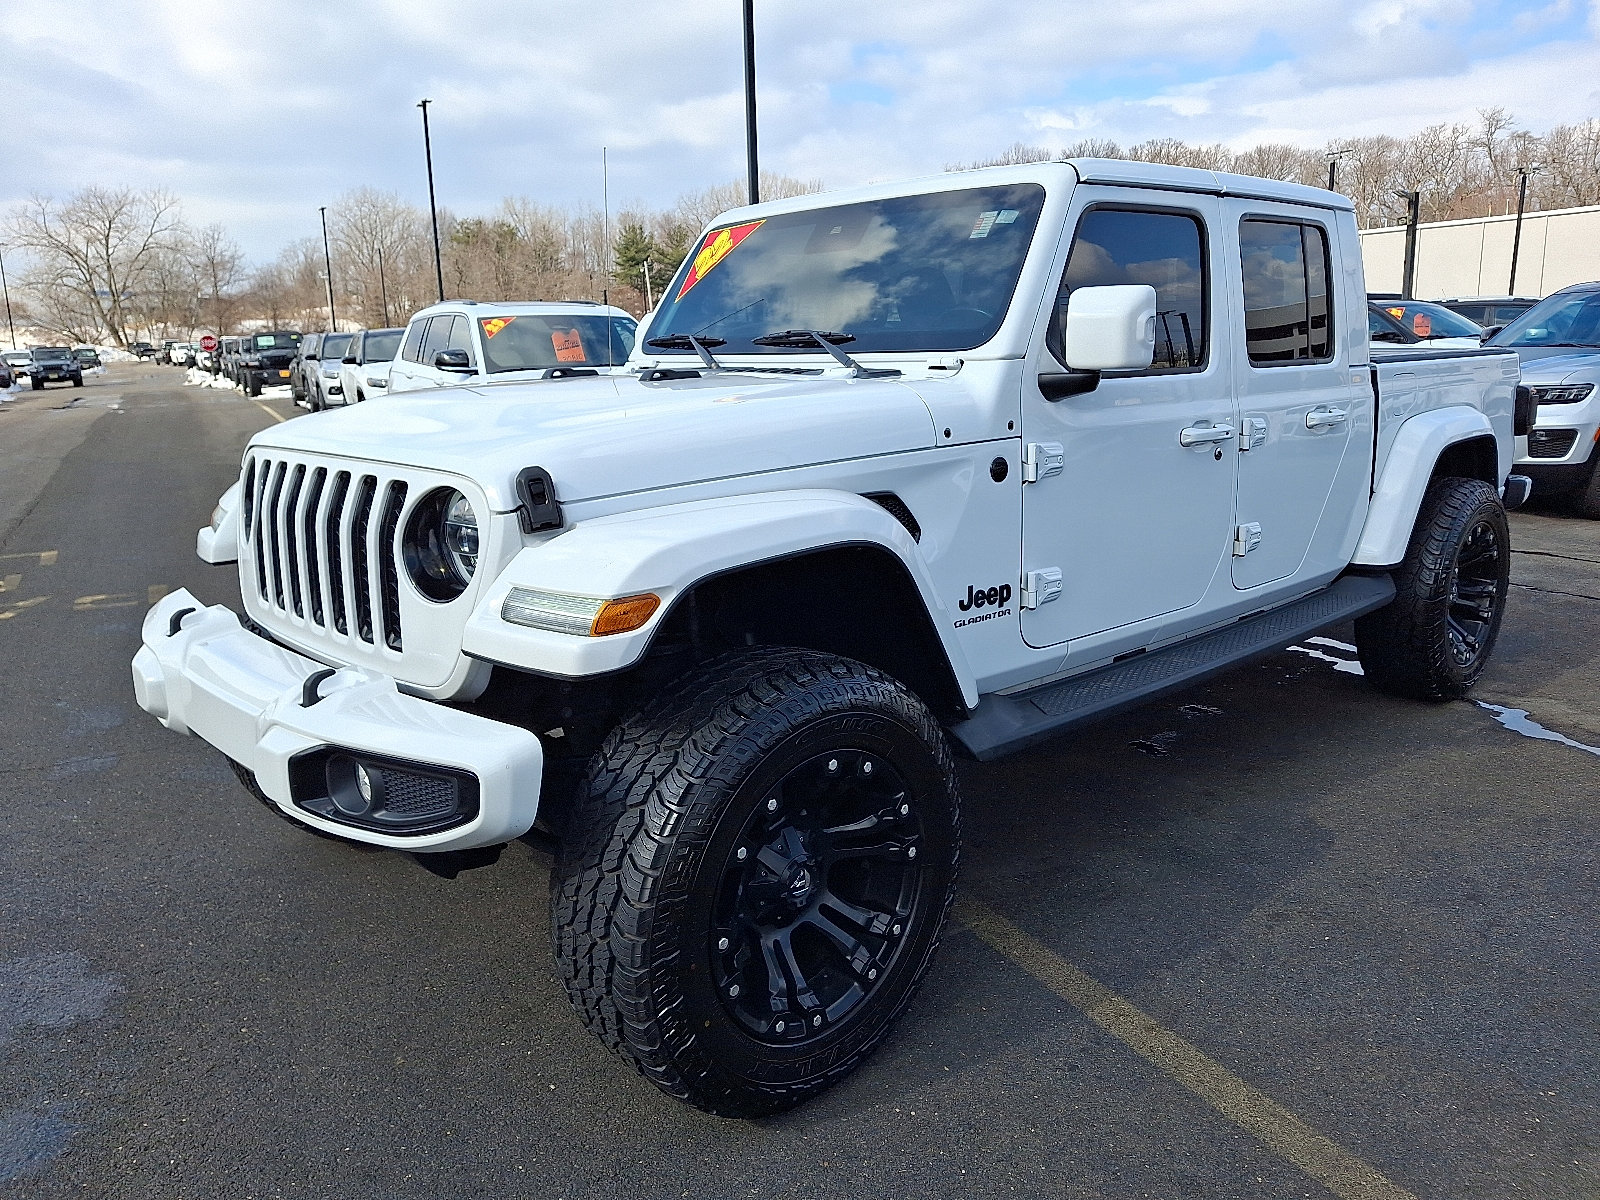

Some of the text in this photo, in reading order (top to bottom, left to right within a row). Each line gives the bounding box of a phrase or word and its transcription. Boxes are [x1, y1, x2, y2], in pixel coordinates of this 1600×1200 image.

[201, 338, 217, 347] STOP
[959, 584, 1011, 611] Jeep
[953, 608, 1012, 629] GLADIATOR
